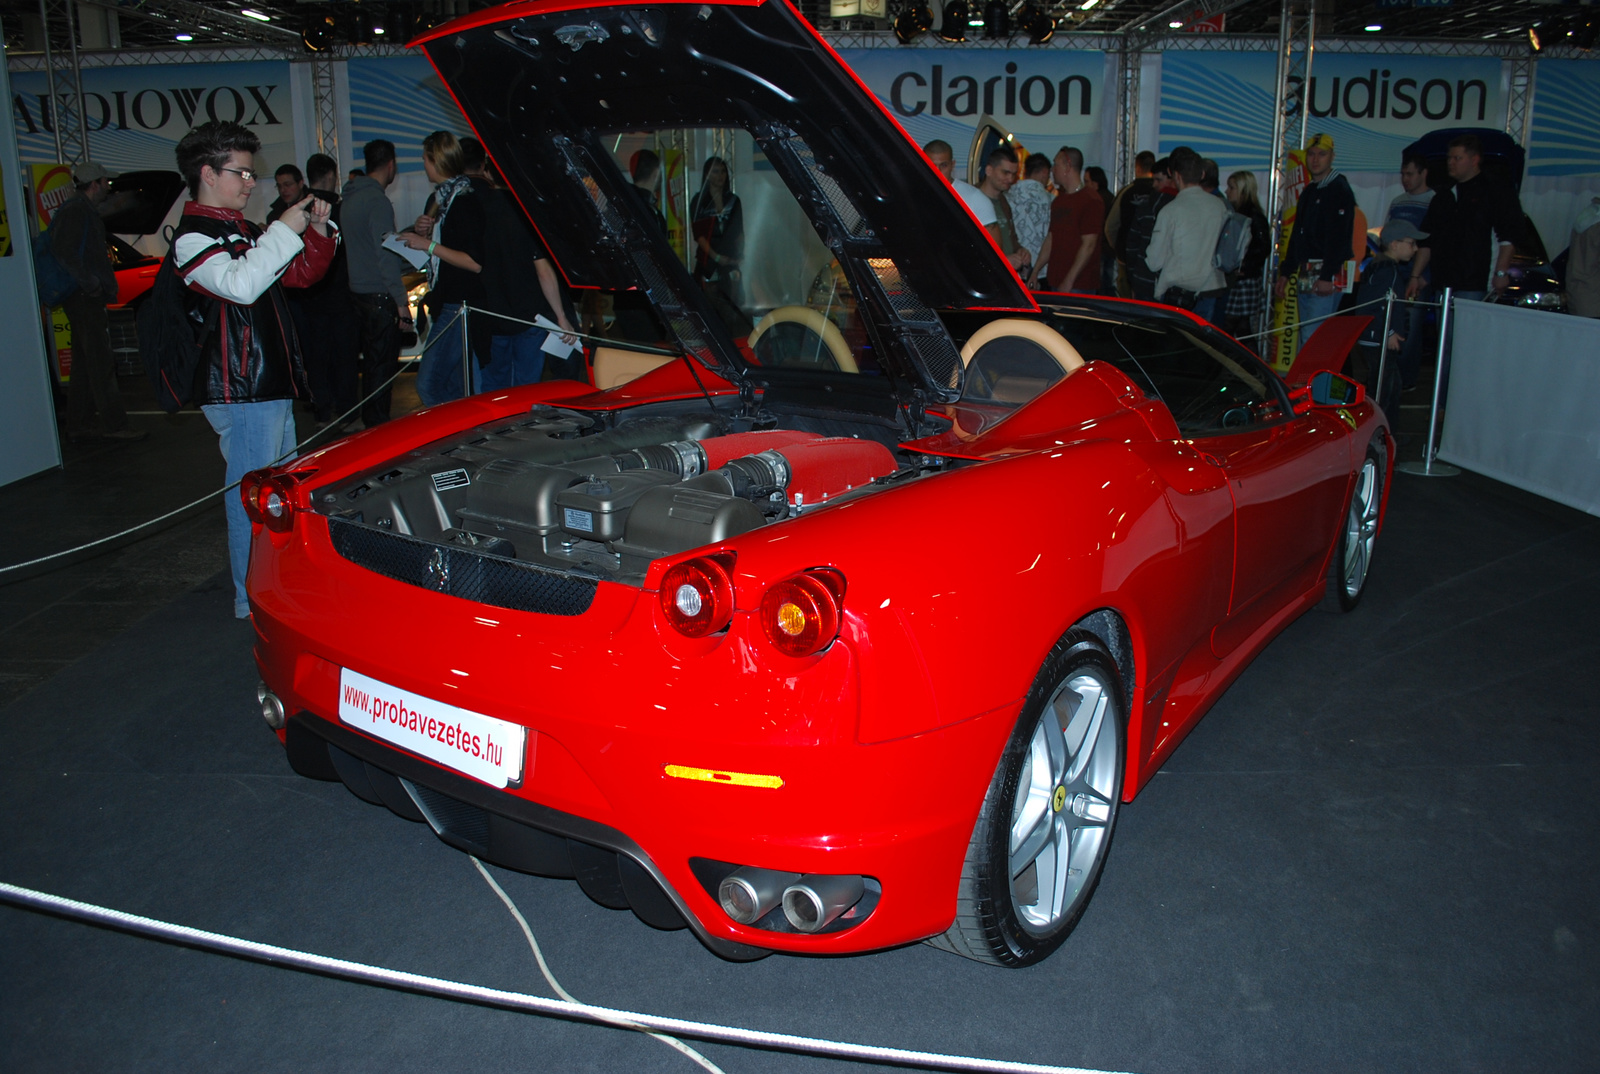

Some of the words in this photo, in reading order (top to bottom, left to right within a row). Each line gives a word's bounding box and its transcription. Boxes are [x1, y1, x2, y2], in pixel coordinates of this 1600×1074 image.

[14, 84, 282, 134] AUDIOVOX
[890, 61, 1091, 116] clarion
[1283, 69, 1488, 120] audison
[1281, 270, 1298, 366] autohifipo
[343, 683, 503, 768] www.probavezetes.hu
